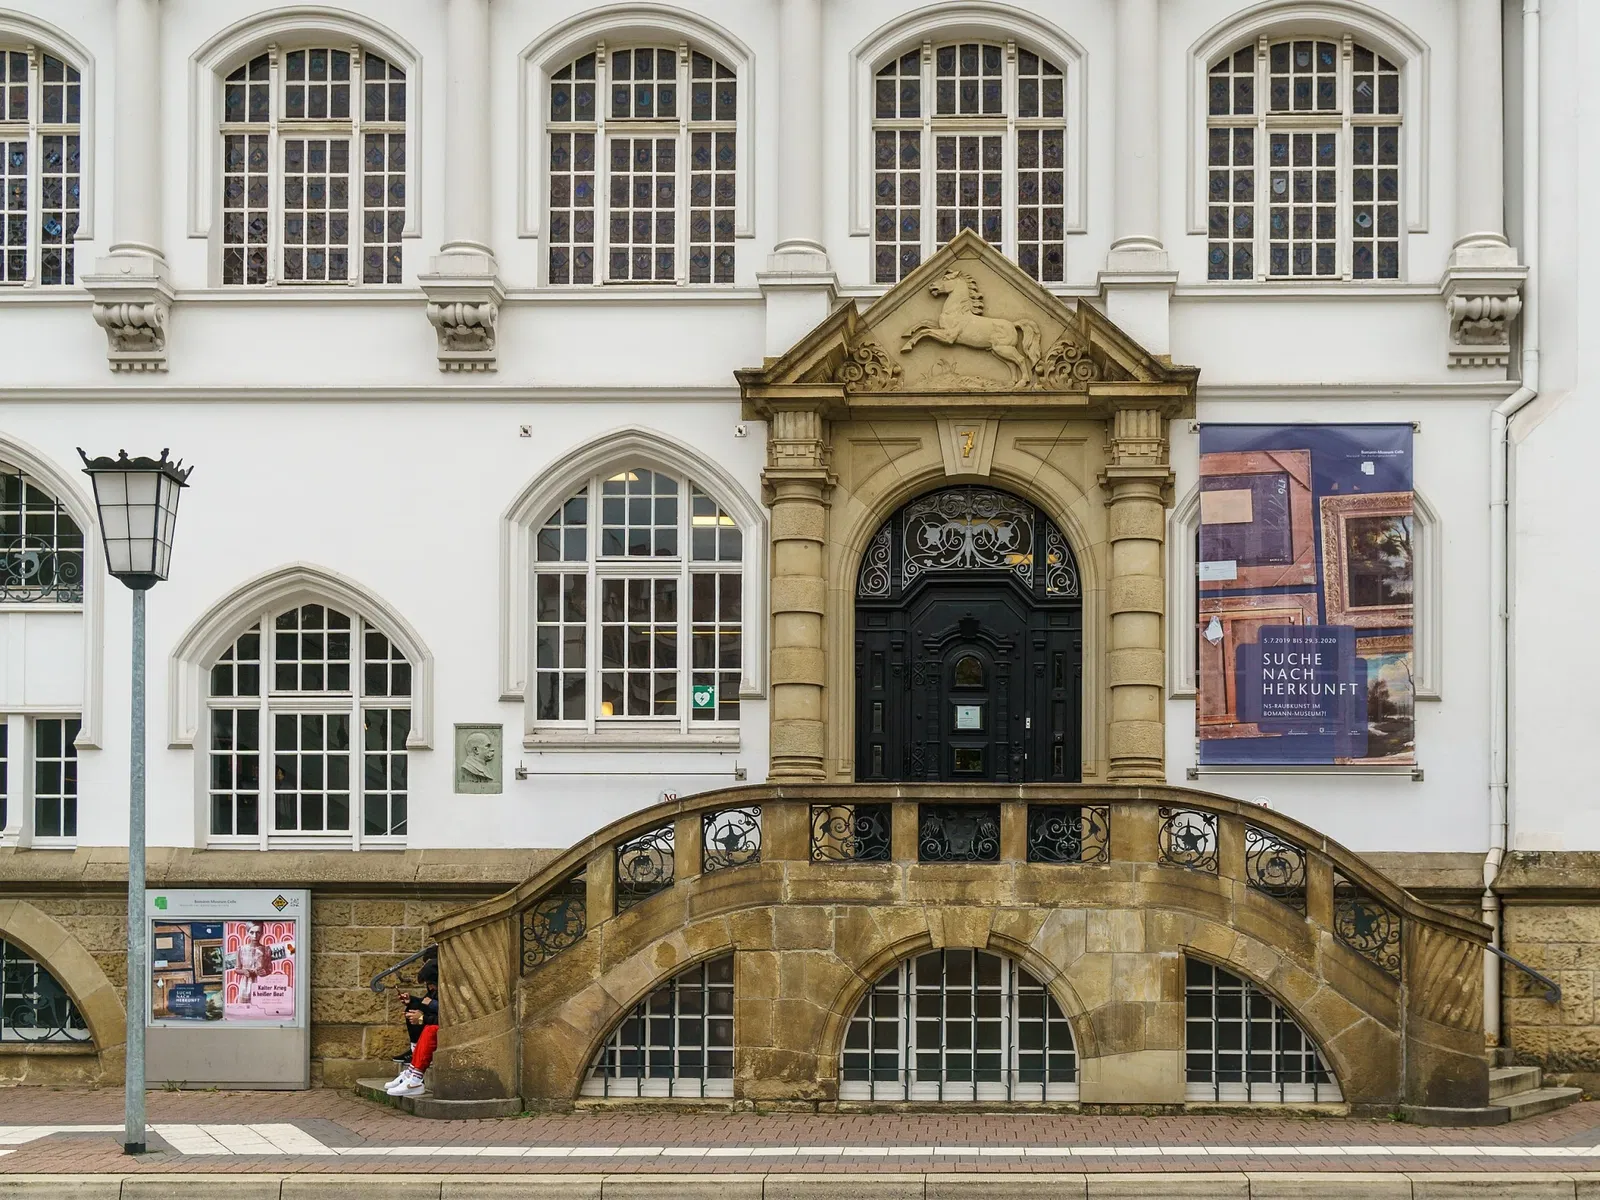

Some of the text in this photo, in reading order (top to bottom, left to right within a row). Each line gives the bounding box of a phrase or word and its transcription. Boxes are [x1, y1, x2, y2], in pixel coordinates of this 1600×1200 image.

[960, 431, 976, 458] 7
[1263, 653, 1322, 665] SUCHE
[1263, 668, 1314, 680] NACH
[1263, 683, 1359, 696] HERKUNFT
